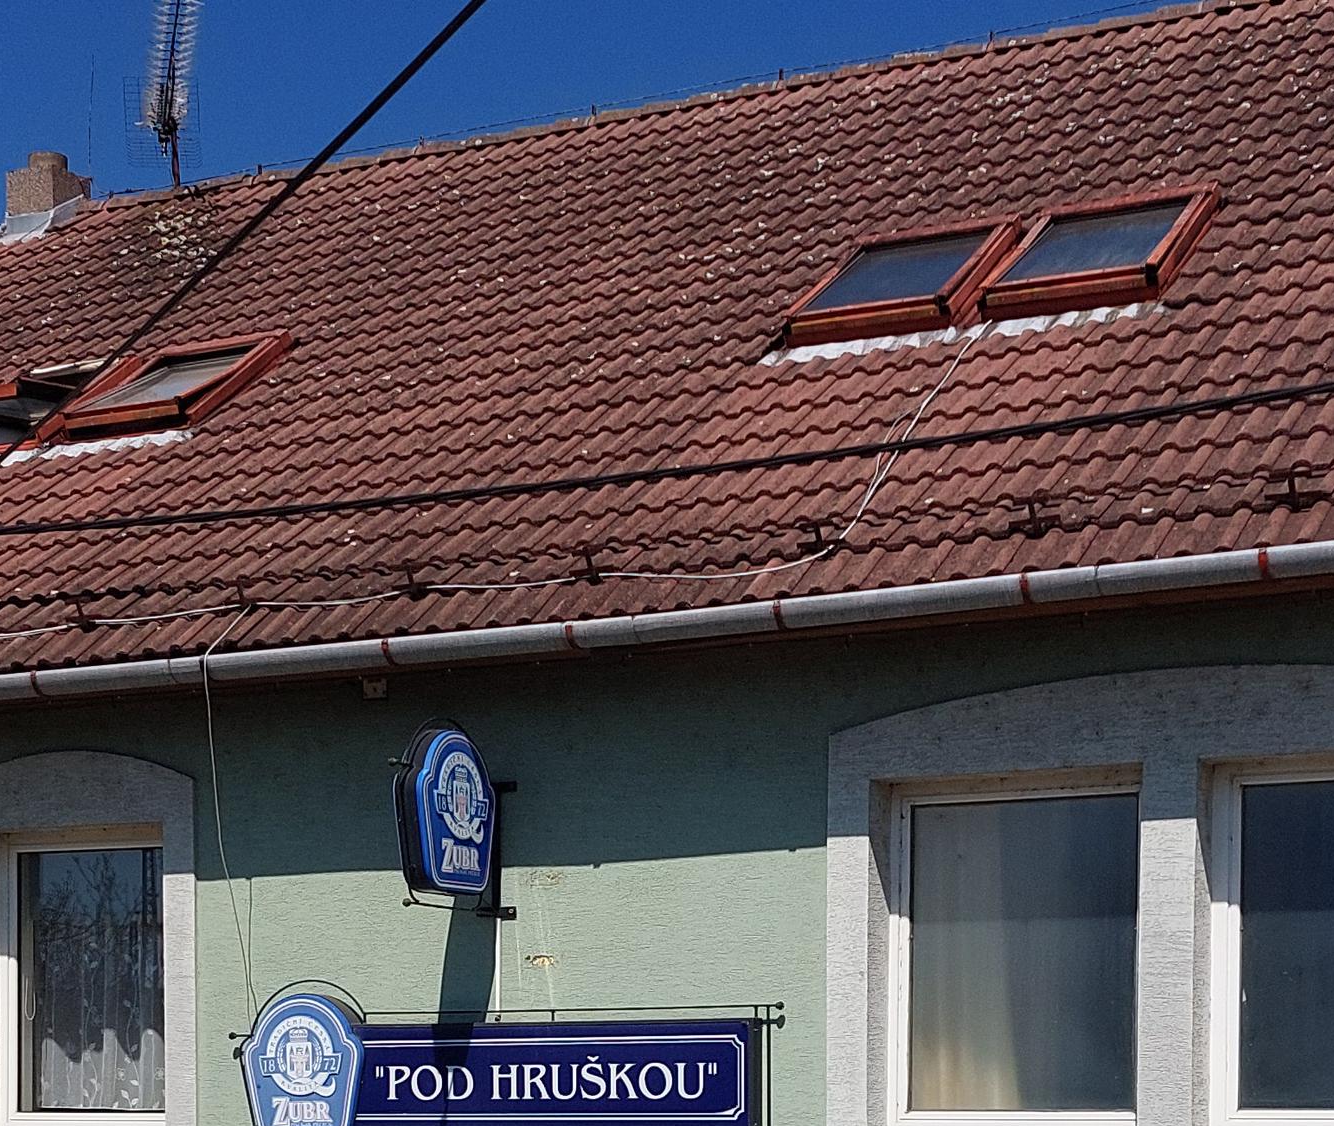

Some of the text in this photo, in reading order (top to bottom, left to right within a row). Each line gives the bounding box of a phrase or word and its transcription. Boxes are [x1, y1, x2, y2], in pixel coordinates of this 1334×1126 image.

[441, 837, 481, 873] ZUBR
[263, 1057, 336, 1073] 18 72
[375, 1055, 718, 1100] "POD HRUŠKOU"
